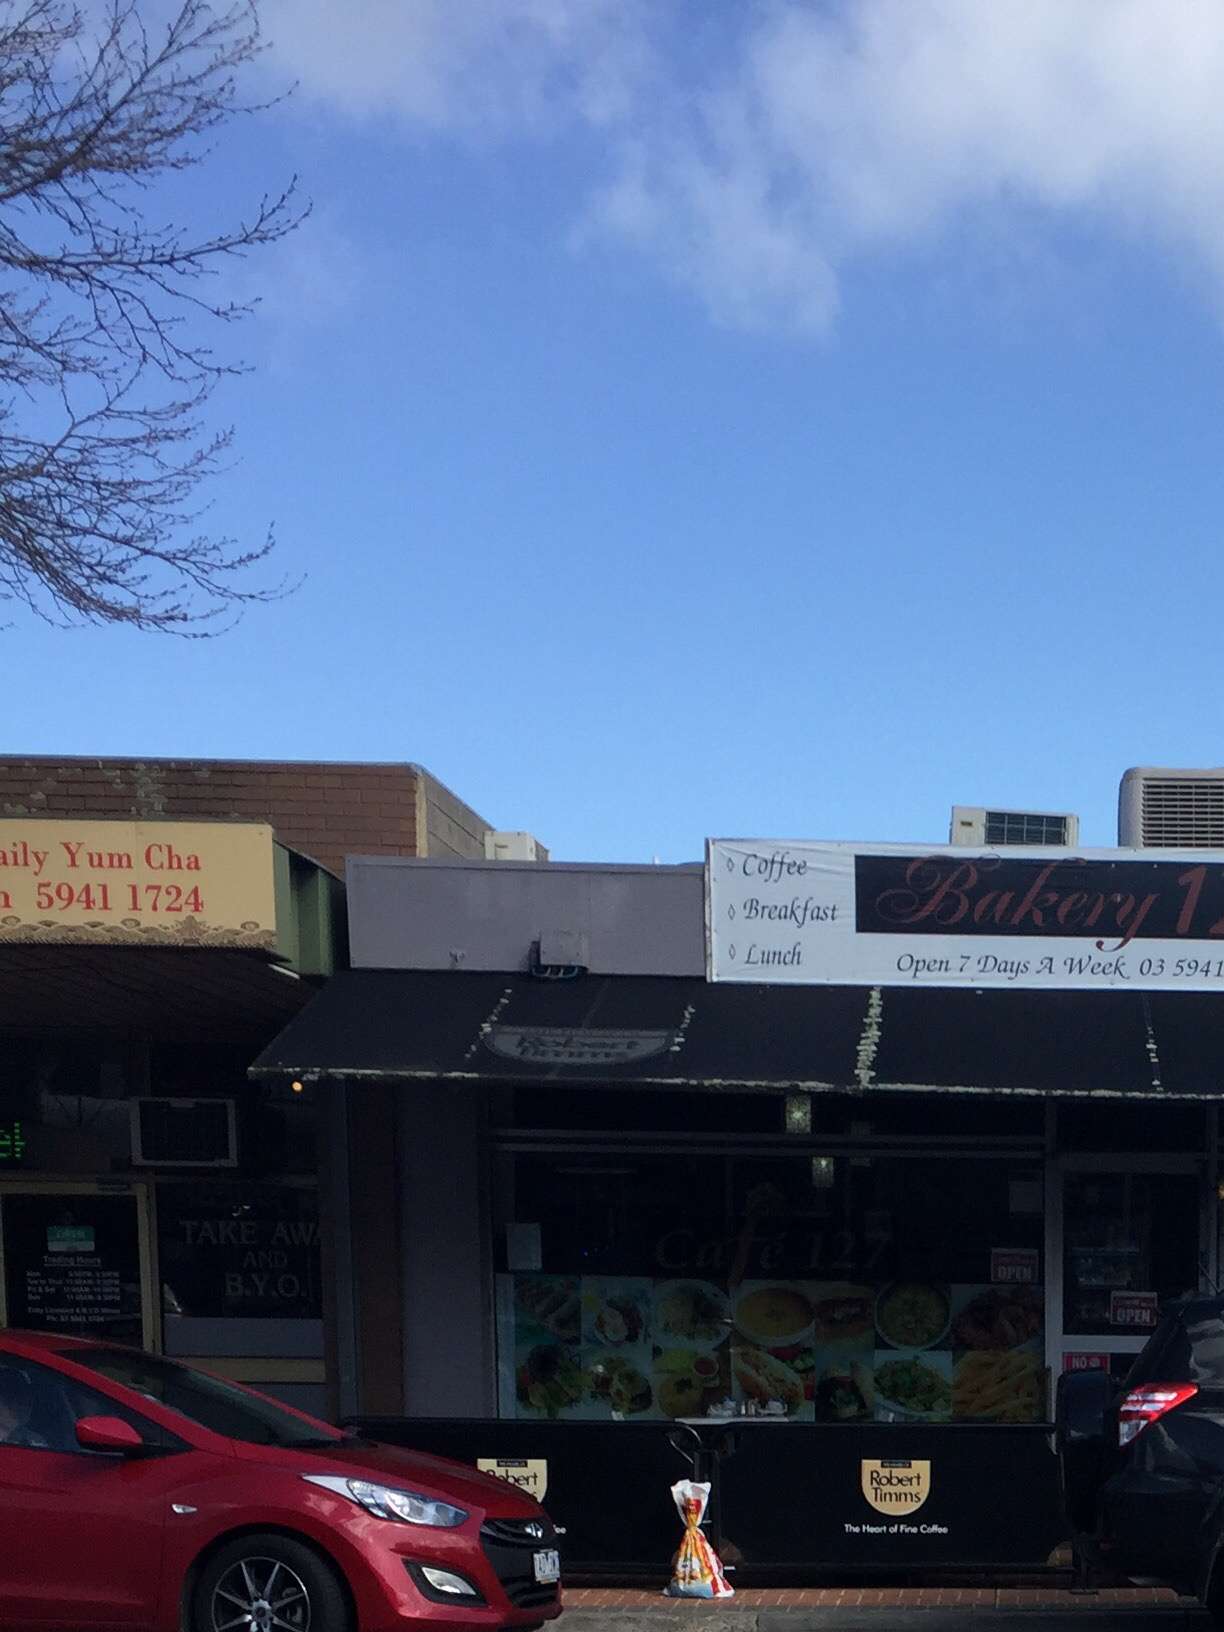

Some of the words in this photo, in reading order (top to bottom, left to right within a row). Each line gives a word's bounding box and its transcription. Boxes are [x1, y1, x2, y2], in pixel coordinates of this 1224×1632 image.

[60, 842, 133, 869] Yum
[145, 843, 201, 870] Cha
[742, 851, 808, 883] Coffee
[36, 881, 112, 911] 5941
[127, 883, 204, 913] 1724
[875, 853, 1165, 952] Bakery
[743, 897, 839, 928] Breakfast
[744, 942, 801, 966] Lunch
[896, 953, 951, 979] Open
[958, 955, 971, 973] 7
[976, 954, 1030, 981] Days
[1036, 957, 1063, 976] A
[1063, 956, 1131, 981] Week
[1139, 958, 1165, 978] 03
[1174, 958, 1224, 978] 5941
[178, 1219, 256, 1246] TAKE
[241, 1250, 289, 1270] AND
[1116, 1308, 1151, 1323] OPEN
[870, 1470, 921, 1486] Robert
[872, 1487, 921, 1503] Timms
[844, 1523, 861, 1533] The
[862, 1523, 887, 1533] Heart
[888, 1523, 898, 1533] of
[899, 1523, 918, 1533] Fine
[920, 1523, 949, 1533] Coffee
